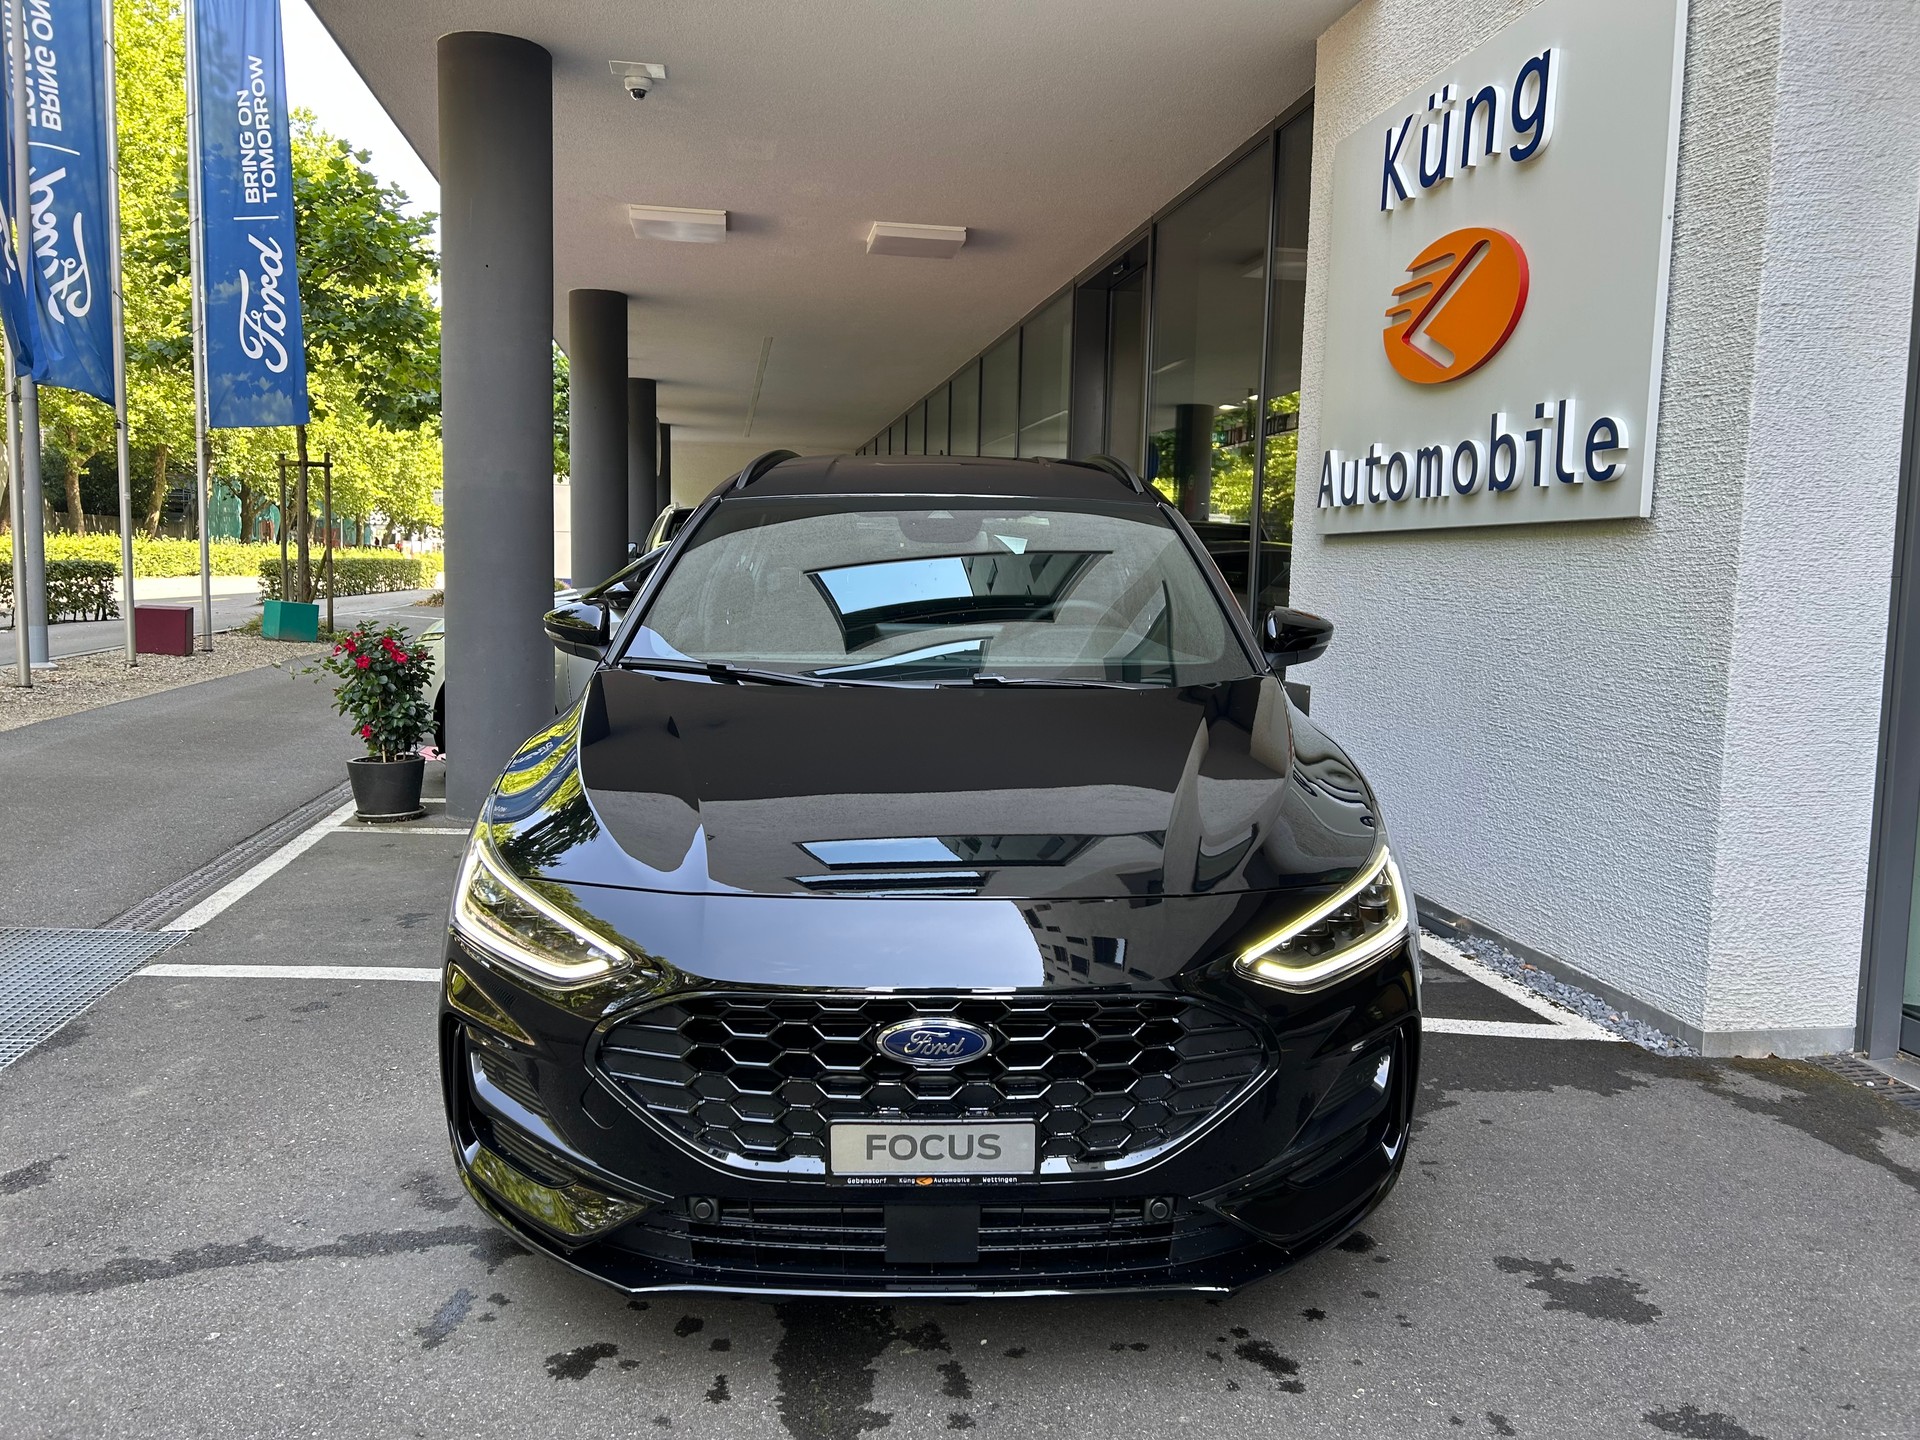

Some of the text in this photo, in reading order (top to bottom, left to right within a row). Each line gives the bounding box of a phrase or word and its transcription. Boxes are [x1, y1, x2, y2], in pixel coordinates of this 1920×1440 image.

[236, 89, 260, 203] BRING ON
[247, 54, 278, 203] TOMORROW
[1380, 48, 1559, 212] Küng
[238, 233, 289, 374] Ford
[1316, 399, 1629, 509] Automobile
[903, 1029, 966, 1056] Ford
[847, 1176, 1018, 1185] Gebenstorf Küng Automobile Wettingen
[865, 1133, 1002, 1161] FOCUS
